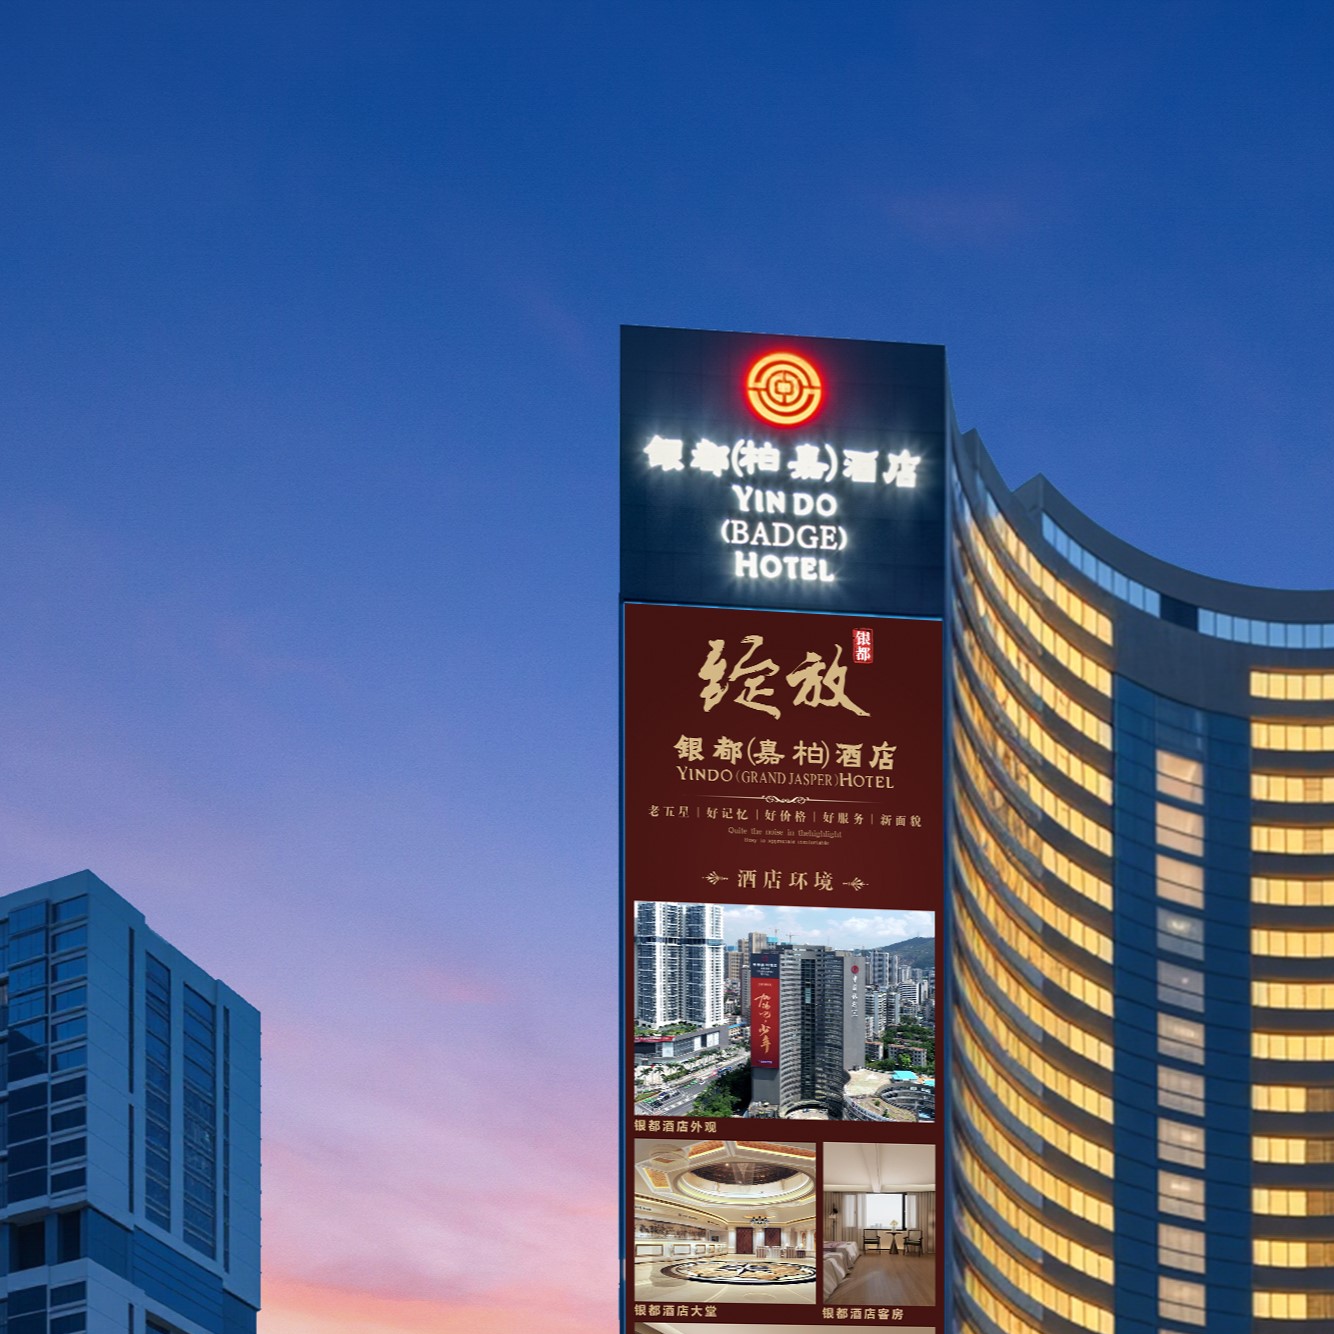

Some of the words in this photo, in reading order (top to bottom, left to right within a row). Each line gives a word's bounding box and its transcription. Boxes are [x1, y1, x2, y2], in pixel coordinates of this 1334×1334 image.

[731, 484, 786, 513] YIN
[793, 492, 838, 517] DO
[721, 519, 848, 551] (BADGE)
[735, 551, 835, 582] HOTEL
[676, 765, 733, 782] YINDO
[737, 868, 834, 892] 酒店环境
[634, 1303, 718, 1318] 银都酒店大堂
[822, 1306, 904, 1321] 银都酒店客房
